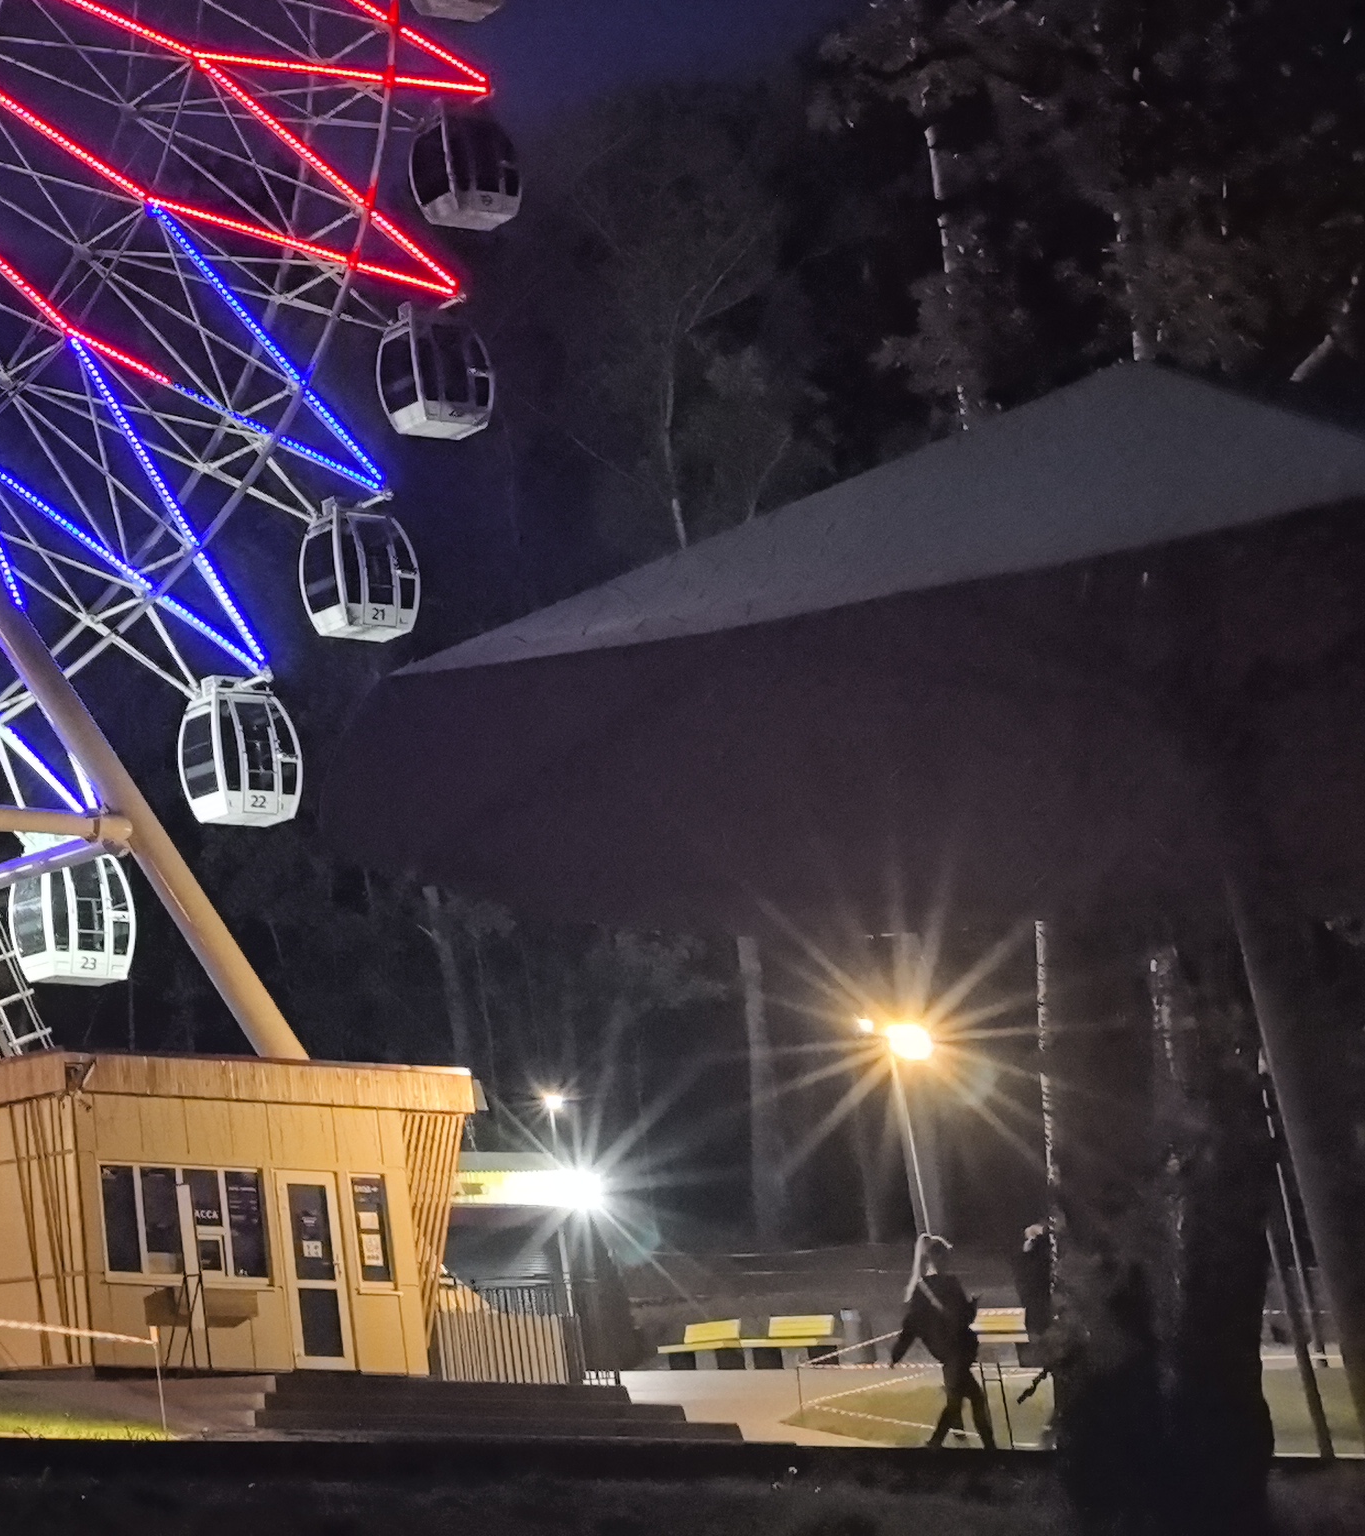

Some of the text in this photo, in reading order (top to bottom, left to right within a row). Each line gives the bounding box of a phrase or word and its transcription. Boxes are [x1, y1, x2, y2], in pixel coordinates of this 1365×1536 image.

[372, 607, 385, 620] 21
[250, 795, 266, 809] 22
[80, 956, 97, 970] 23
[194, 1209, 219, 1220] АССА
